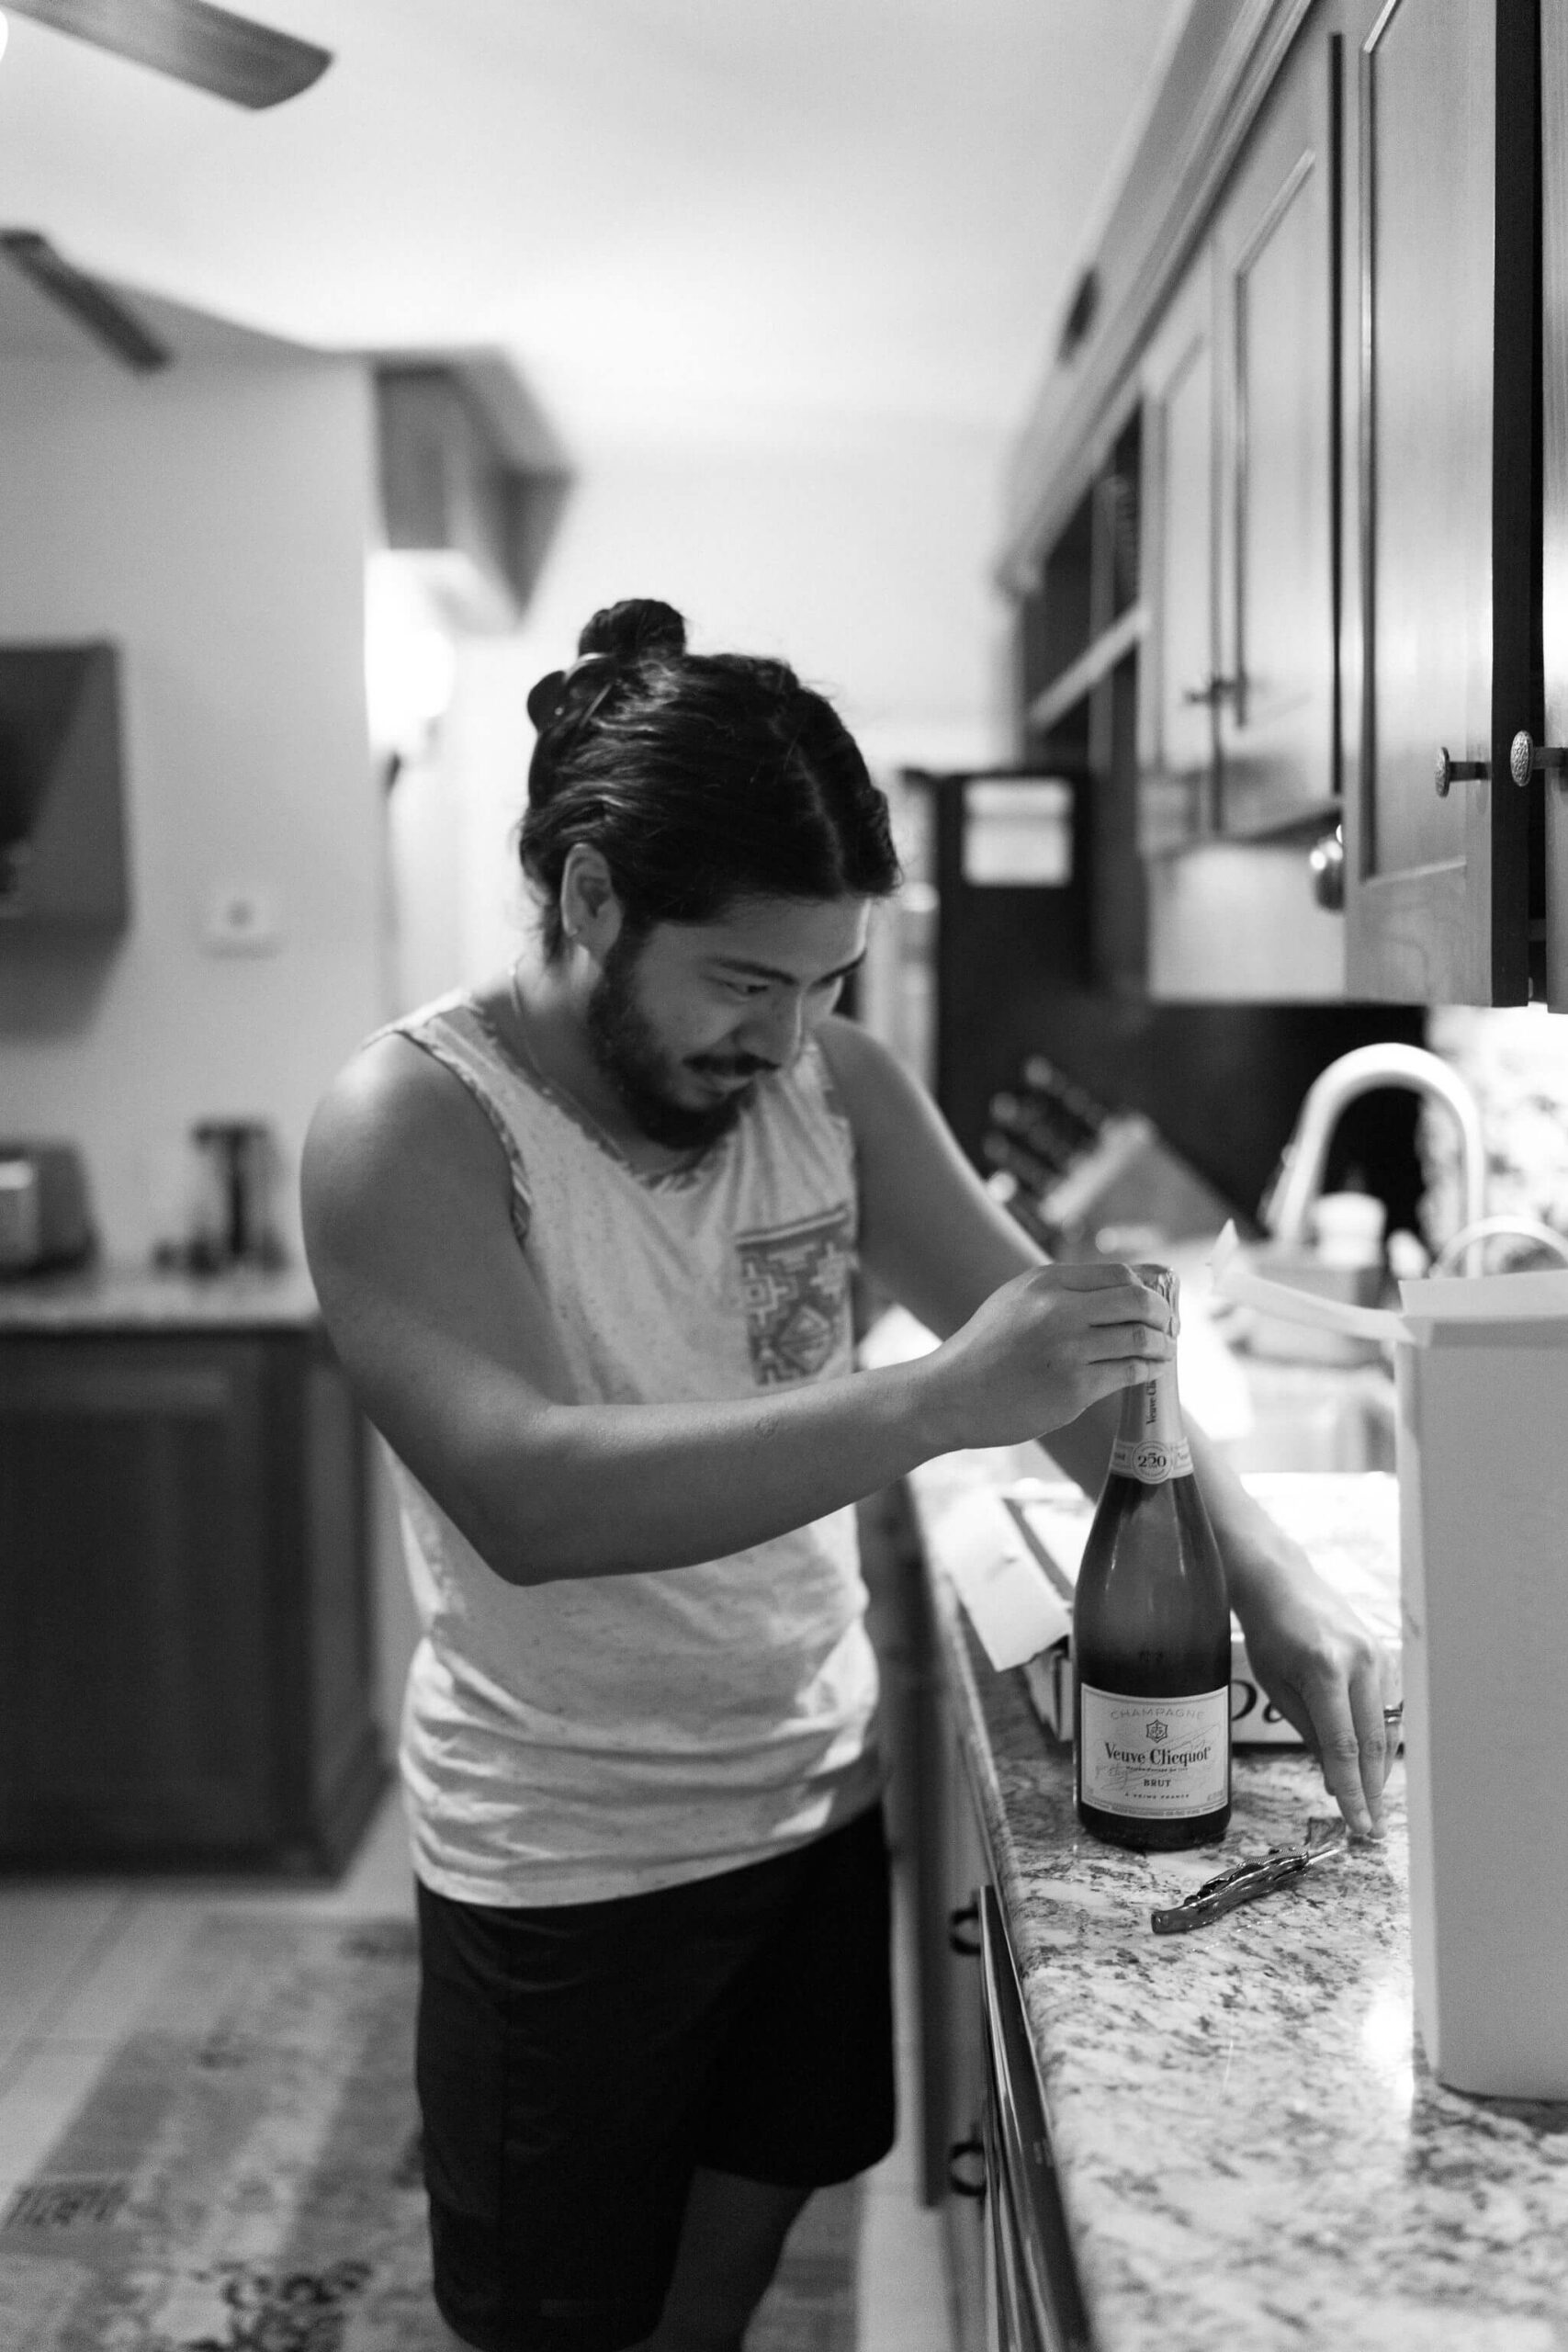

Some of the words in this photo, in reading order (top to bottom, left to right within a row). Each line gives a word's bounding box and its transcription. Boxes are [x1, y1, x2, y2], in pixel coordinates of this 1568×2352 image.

[1145, 1397, 1156, 1425] Veuve
[1138, 1453, 1167, 1467] 250
[1110, 1708, 1205, 1721] CHAMPAGNE
[1105, 1741, 1146, 1765] Veuve
[1149, 1747, 1210, 1768] Clicquot
[1143, 1778, 1171, 1787] BRUT
